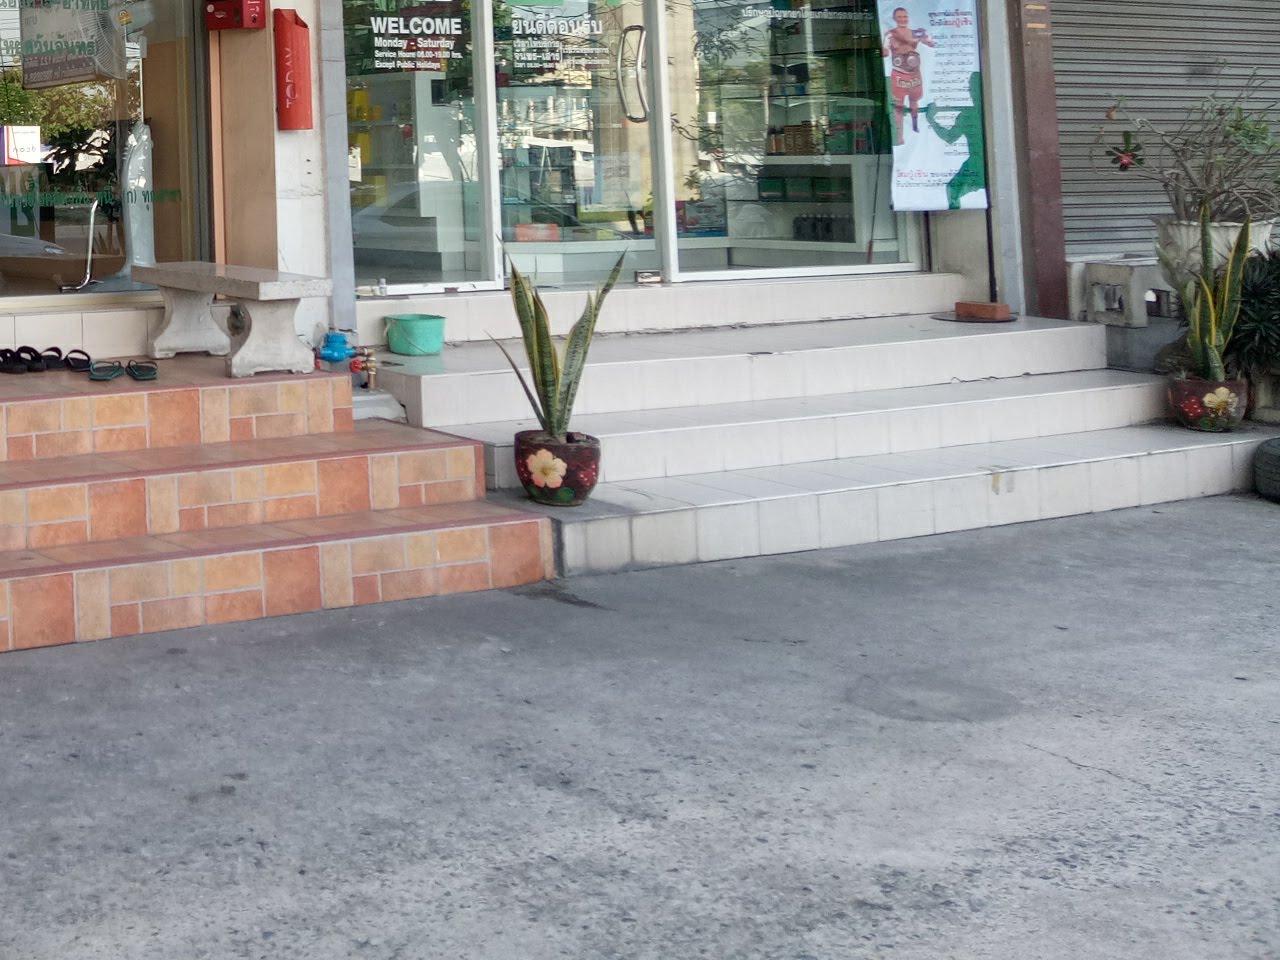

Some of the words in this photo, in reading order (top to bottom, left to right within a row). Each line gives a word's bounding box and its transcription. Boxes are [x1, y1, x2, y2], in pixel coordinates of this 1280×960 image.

[370, 16, 463, 35] WELCOME
[374, 36, 408, 50] Monday
[417, 37, 455, 50] Saturday
[374, 50, 397, 58] Service
[374, 60, 396, 70] Except
